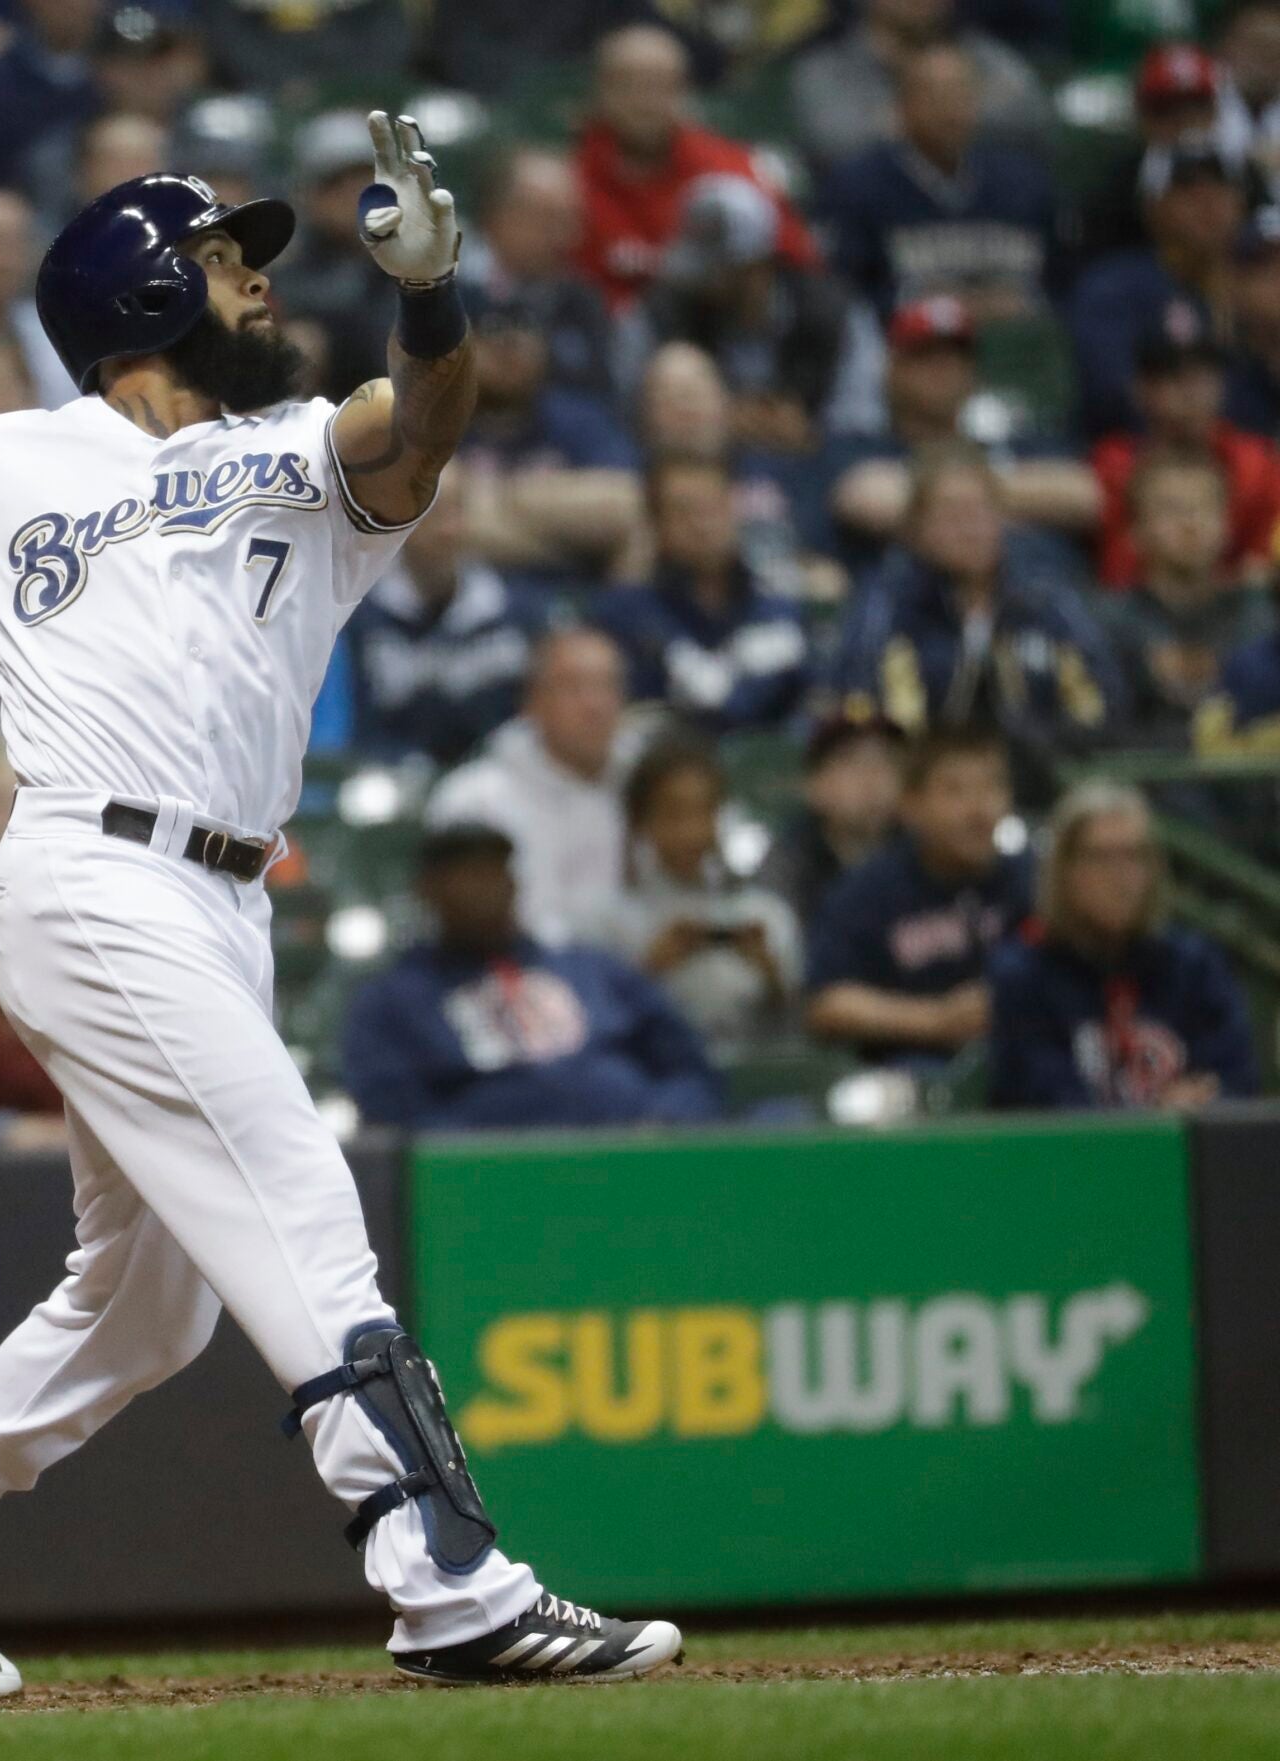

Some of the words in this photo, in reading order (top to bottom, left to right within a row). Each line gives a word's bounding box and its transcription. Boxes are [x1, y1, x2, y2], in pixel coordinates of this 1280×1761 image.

[8, 451, 328, 628] Brewers
[243, 536, 295, 624] 7
[461, 1286, 1144, 1446] SUBWAY
[425, 1656, 432, 1668] 7
